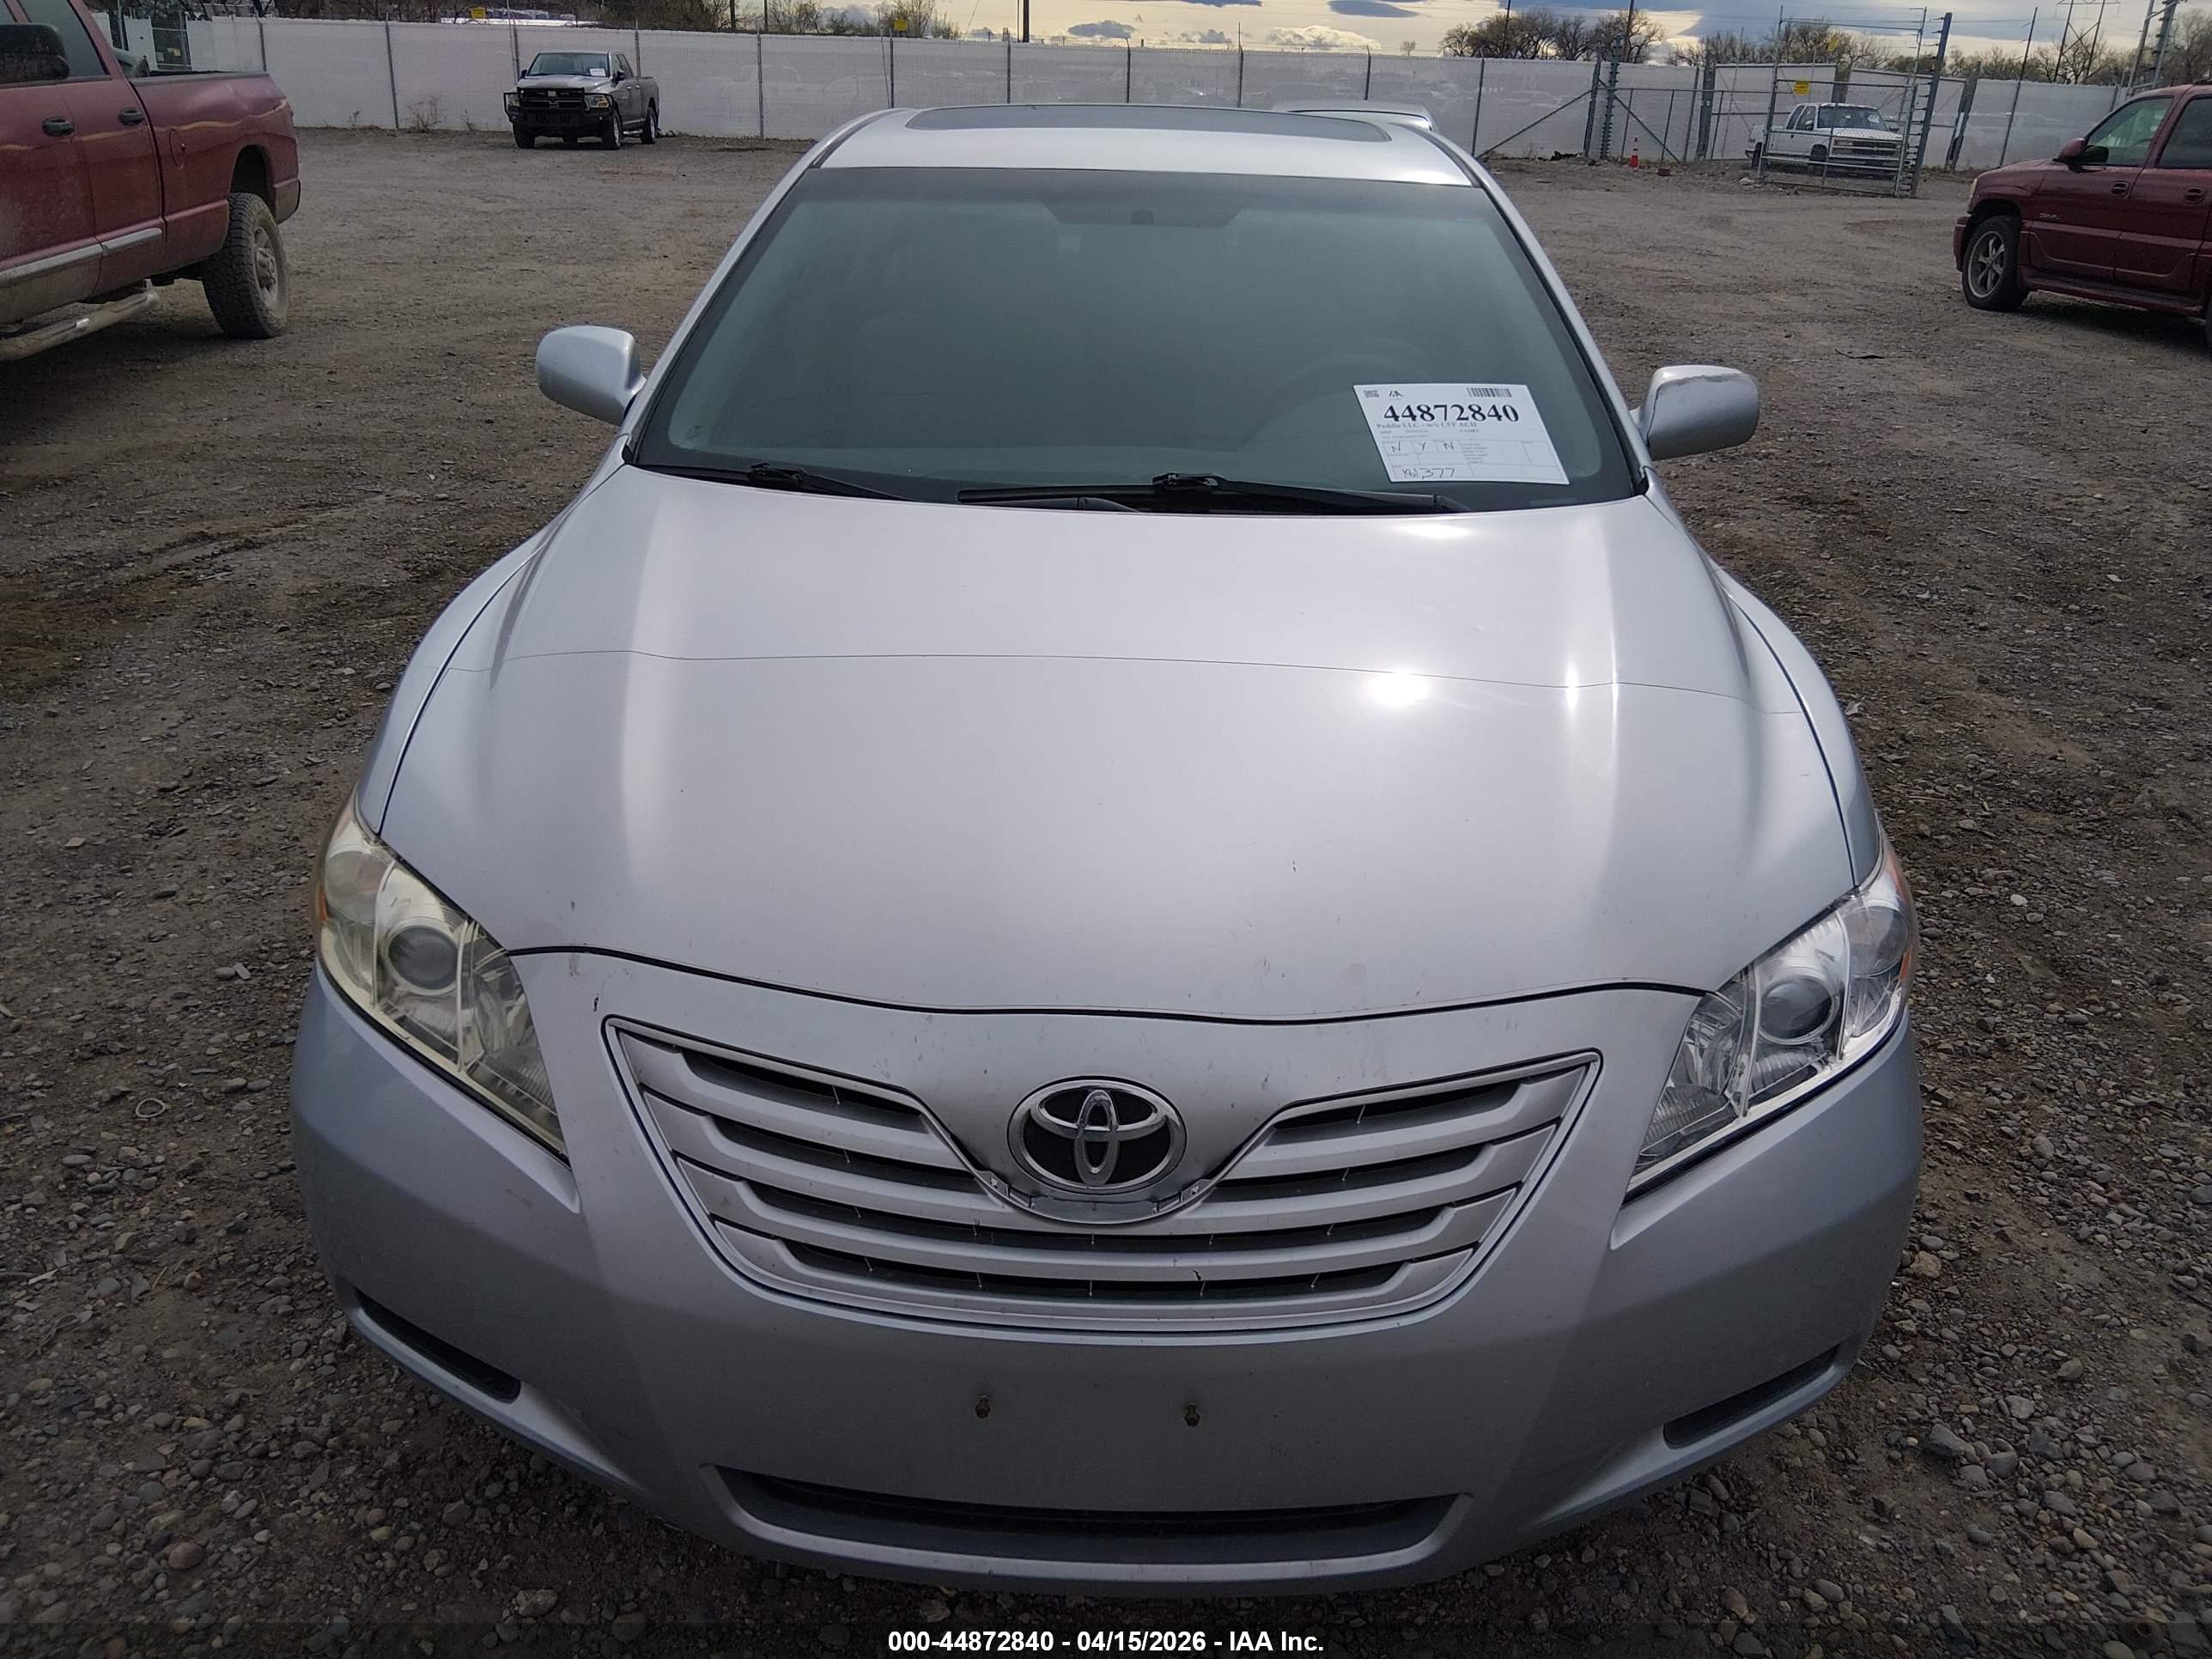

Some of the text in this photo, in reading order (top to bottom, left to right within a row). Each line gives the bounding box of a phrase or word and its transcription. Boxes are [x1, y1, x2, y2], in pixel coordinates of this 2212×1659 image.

[1383, 404, 1519, 422] 44872840
[1391, 441, 1401, 453] N
[1418, 441, 1426, 451] Y
[1443, 441, 1455, 450] N
